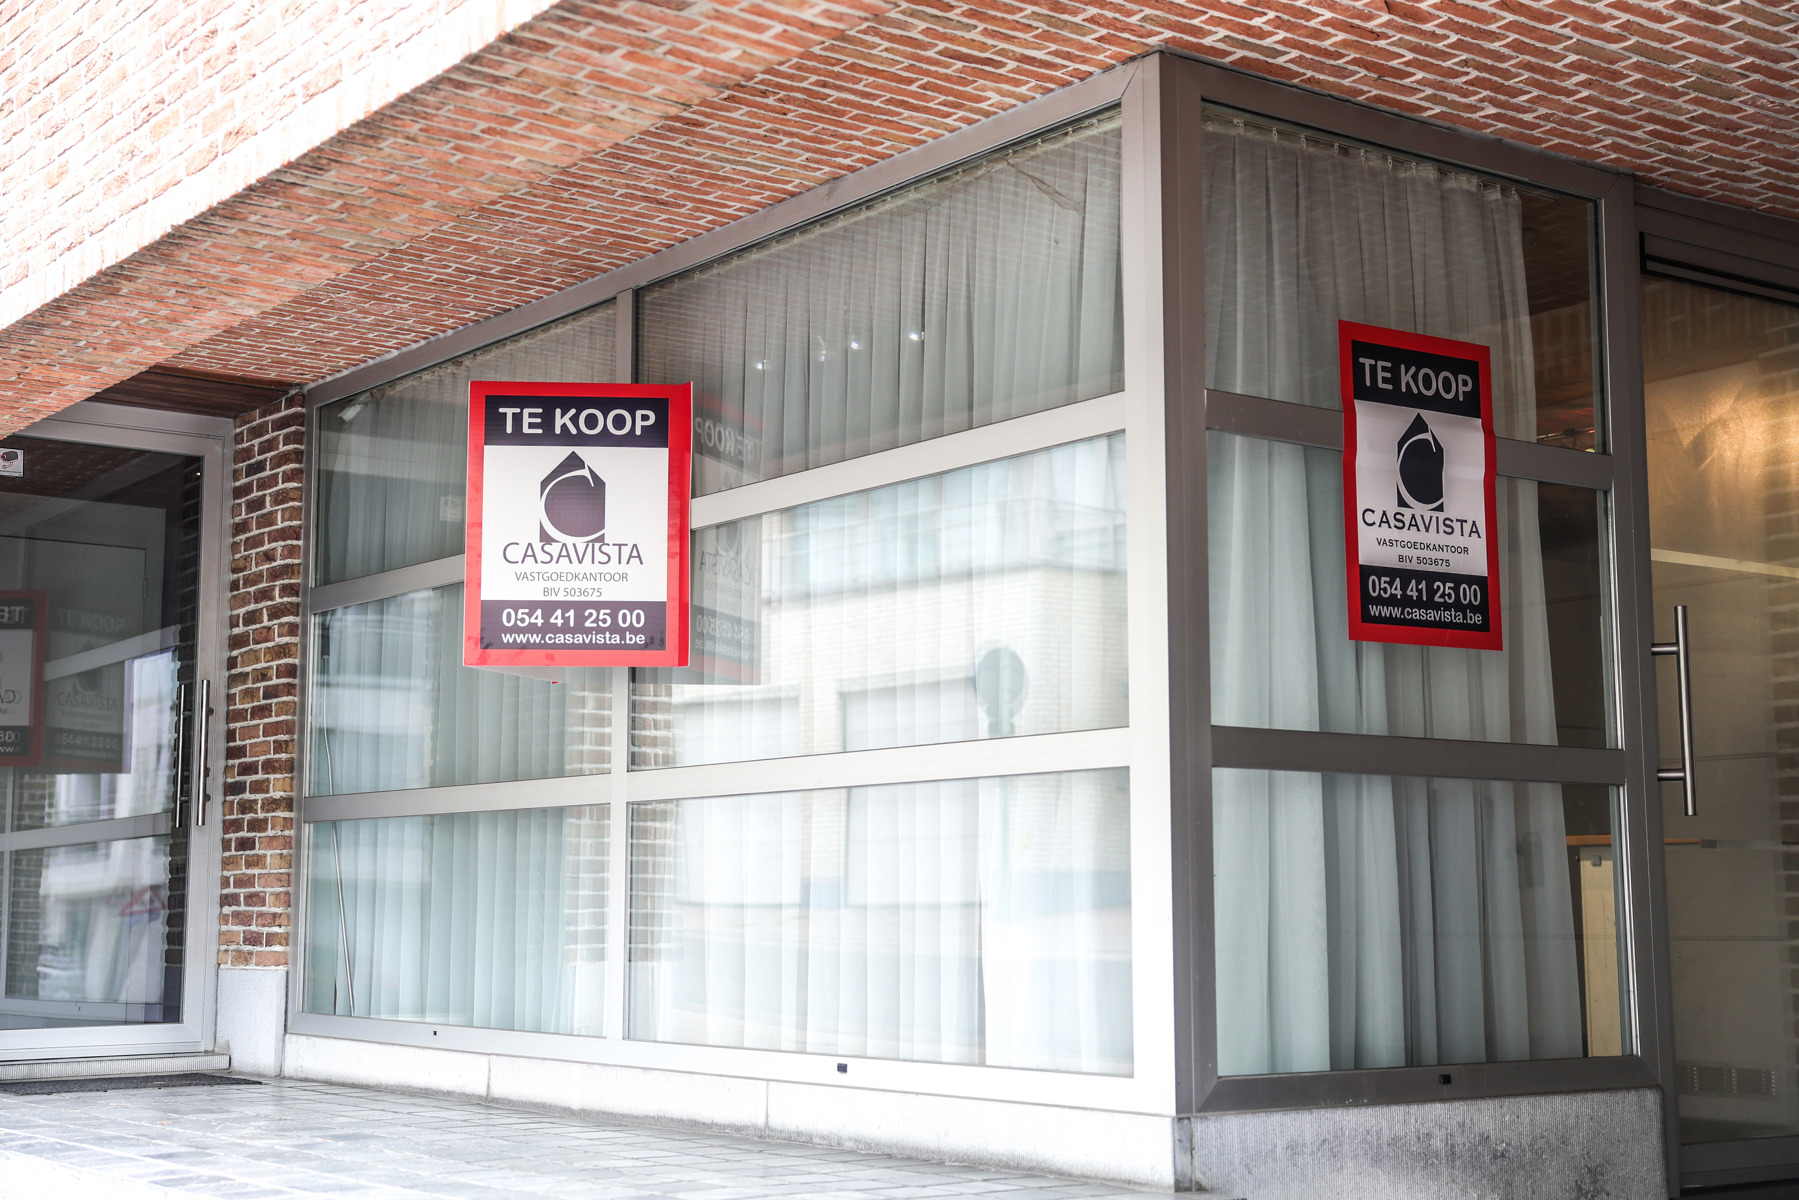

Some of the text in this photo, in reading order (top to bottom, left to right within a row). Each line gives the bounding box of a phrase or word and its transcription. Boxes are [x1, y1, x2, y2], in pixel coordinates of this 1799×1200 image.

[1358, 357, 1473, 402] TE KOOP
[498, 407, 656, 436] TE KOOP
[1361, 507, 1482, 539] CASAVISTA
[502, 541, 644, 566] CASAVISTA
[1376, 537, 1469, 555] VASTGOEDKANTOOR
[1398, 554, 1451, 567] BIV 503675
[514, 571, 629, 583] VASTGOEDKANTOOR
[543, 587, 603, 598] BIV 503675
[1368, 575, 1481, 606] 054 41 25 00
[501, 608, 646, 628] 054 41 25 00
[1368, 604, 1483, 625] www.casavista.be
[501, 630, 646, 645] www.casavista.be
